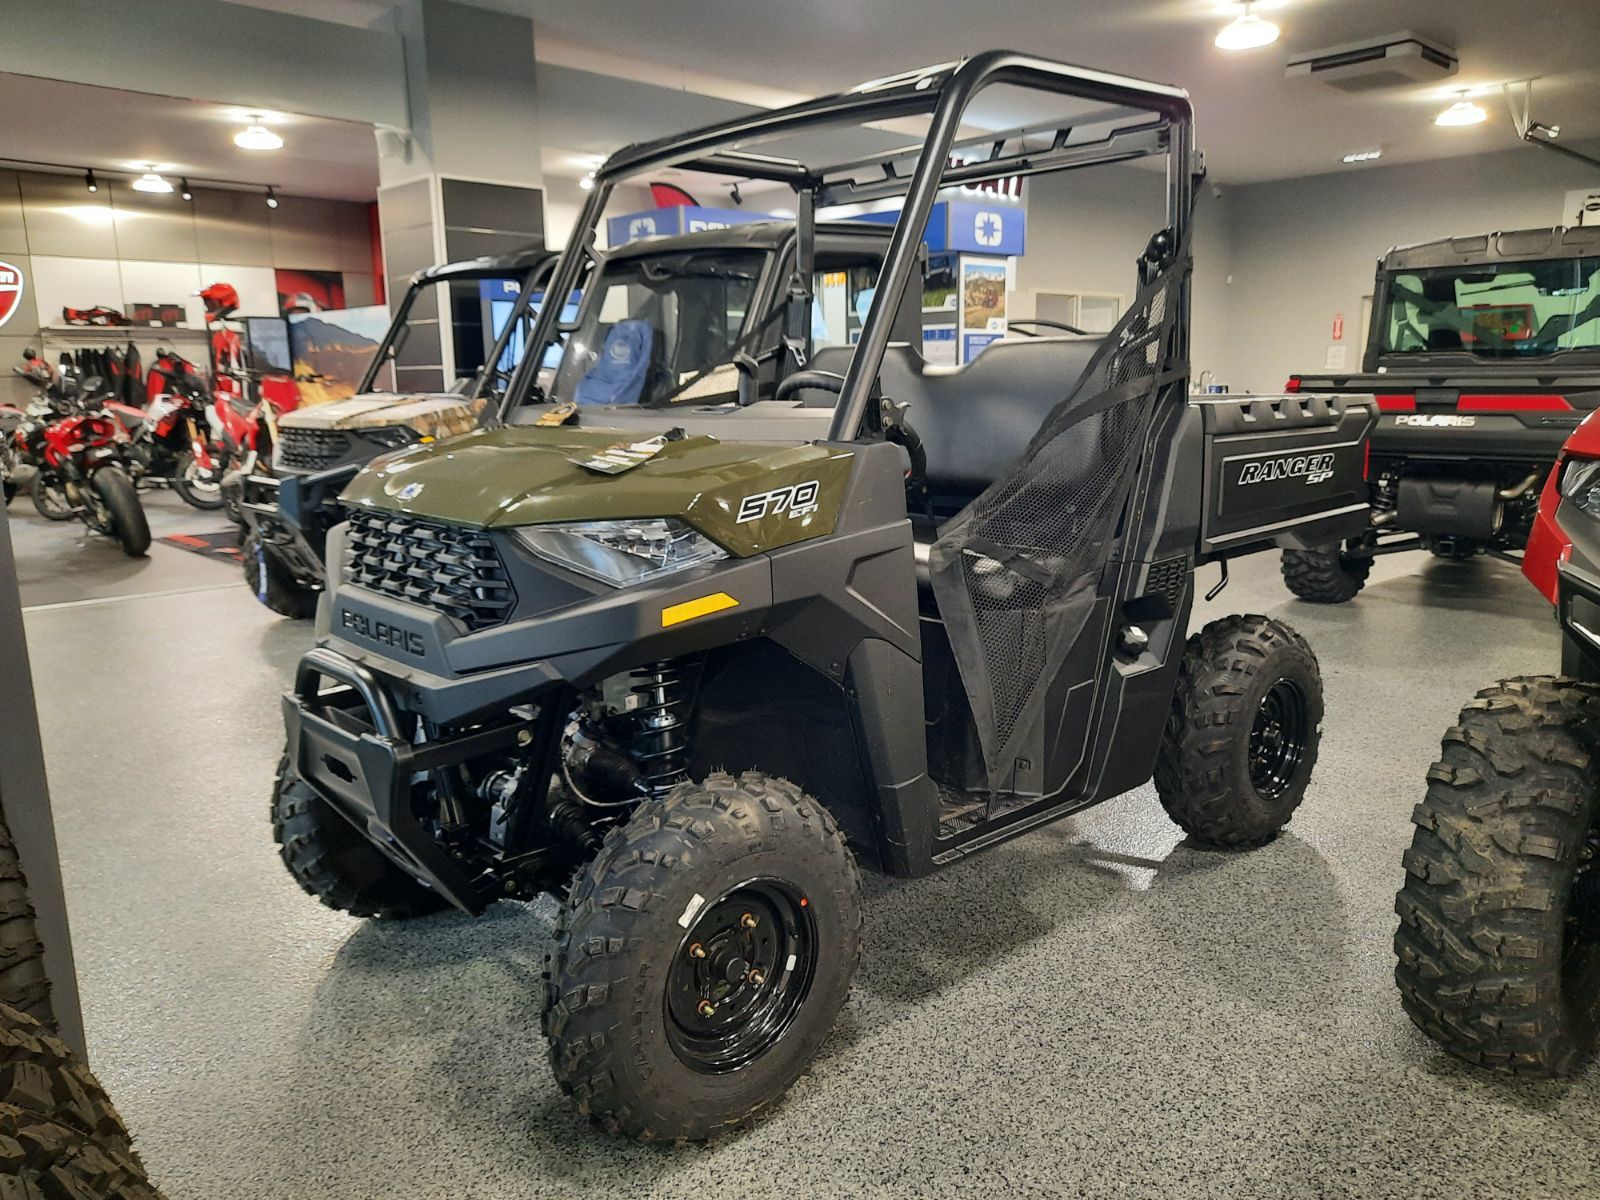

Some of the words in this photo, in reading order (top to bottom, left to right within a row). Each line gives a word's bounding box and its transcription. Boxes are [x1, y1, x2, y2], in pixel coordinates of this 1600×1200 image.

[1394, 415, 1476, 428] POLARIS
[1238, 453, 1335, 485] RANGER
[1305, 470, 1334, 485] SP
[736, 480, 819, 525] 570
[788, 503, 819, 519] EFI
[342, 608, 425, 657] POLARIS
